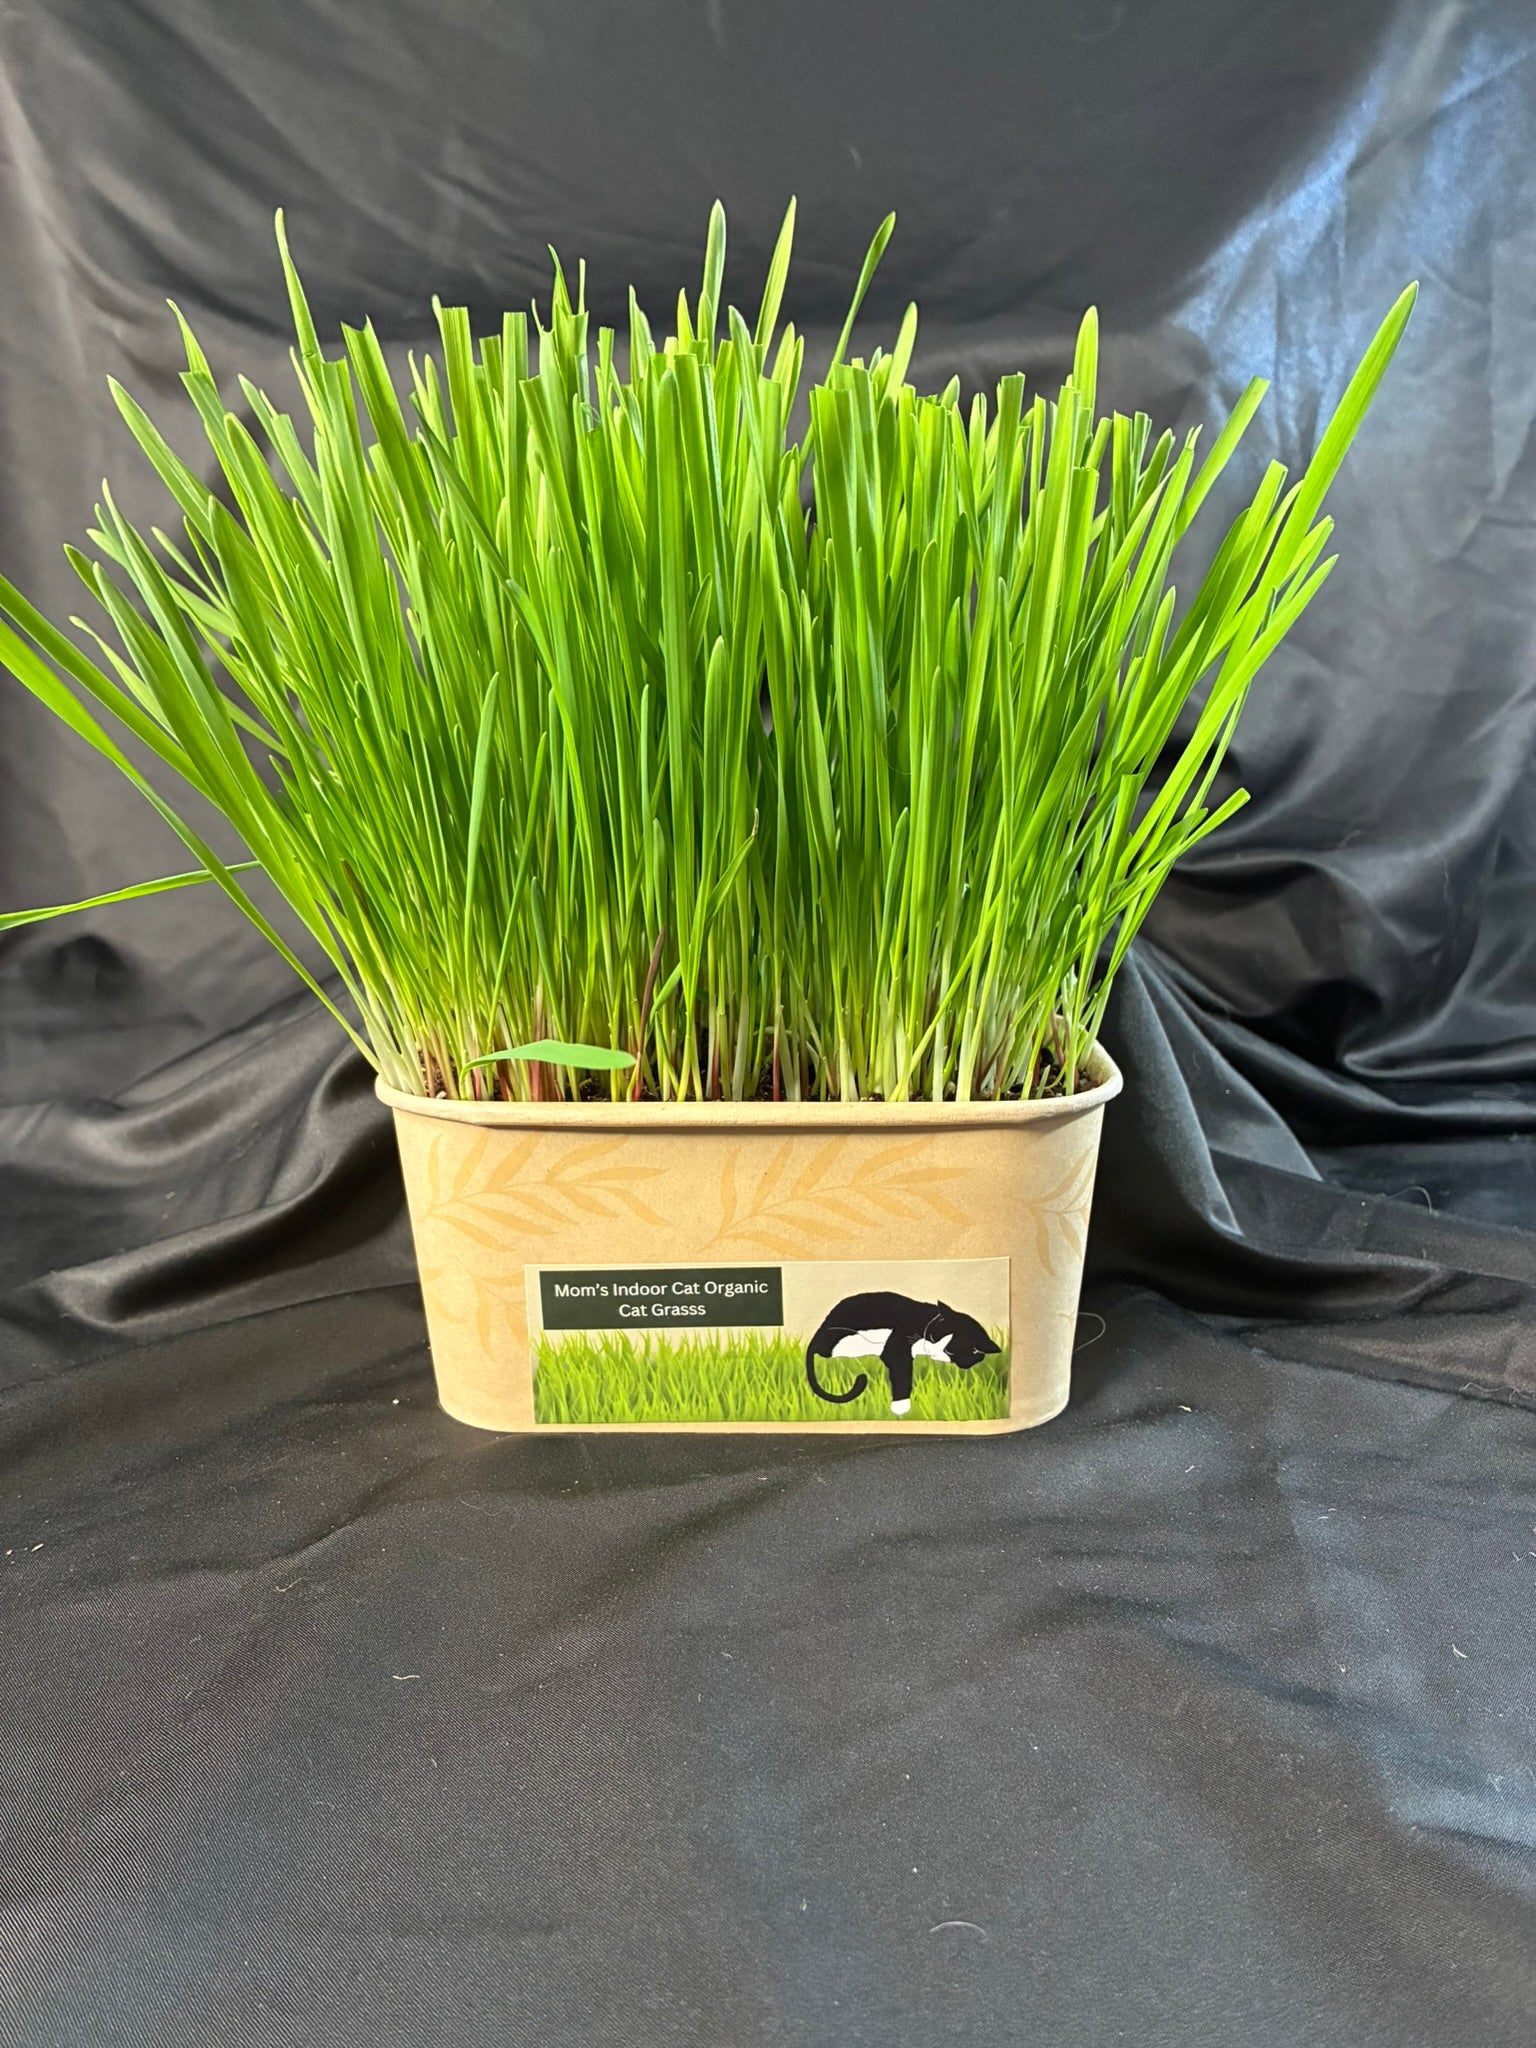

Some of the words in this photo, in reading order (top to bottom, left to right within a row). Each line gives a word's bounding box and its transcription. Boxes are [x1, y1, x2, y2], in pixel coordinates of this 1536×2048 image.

[554, 1282, 609, 1298] Mom's
[612, 1281, 668, 1297] Indoor
[671, 1281, 701, 1296] Cat
[703, 1280, 769, 1298] Organic
[618, 1303, 648, 1318] Cat
[651, 1303, 707, 1317] Grasss
